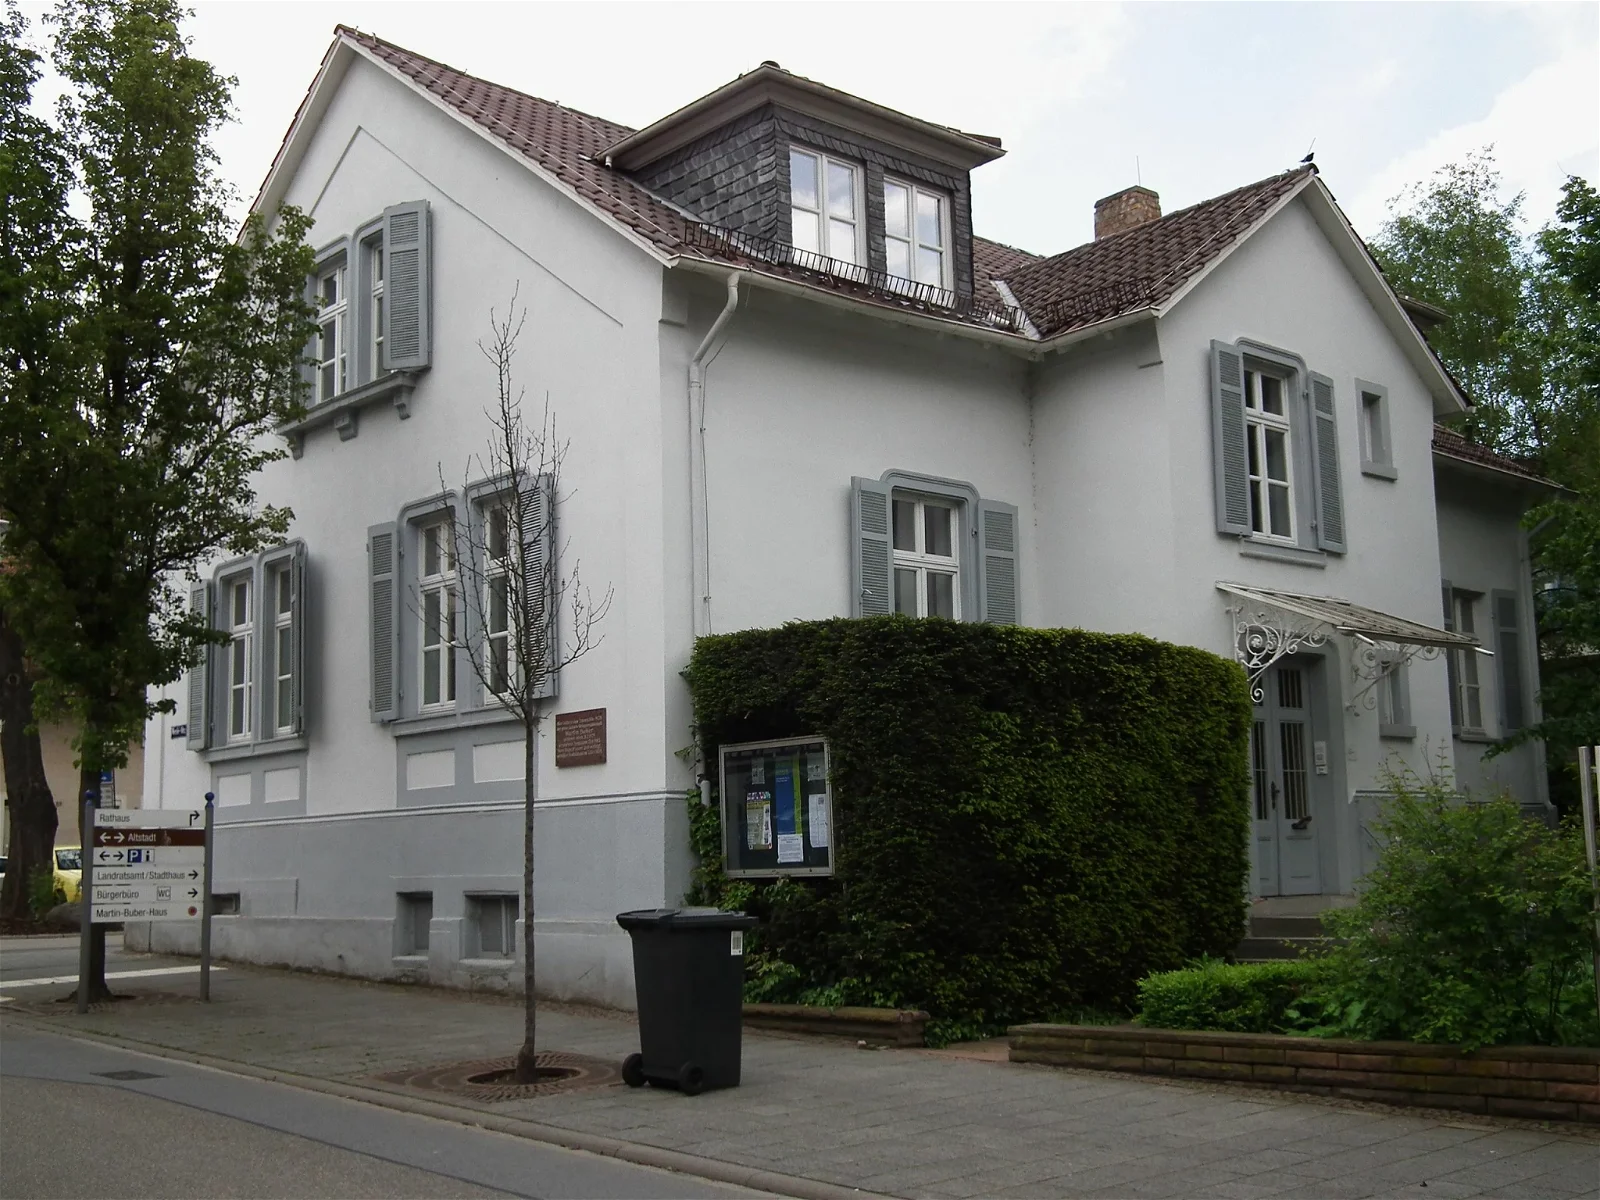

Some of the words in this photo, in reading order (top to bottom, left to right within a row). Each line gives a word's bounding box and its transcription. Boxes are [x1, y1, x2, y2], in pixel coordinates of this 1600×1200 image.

[99, 813, 130, 822] Rathaus
[128, 833, 156, 842] Altstadt
[130, 850, 139, 862] P
[96, 890, 139, 900] Bürgerbüro
[158, 889, 171, 898] WC
[96, 907, 168, 918] Martin-Buber-Haus
